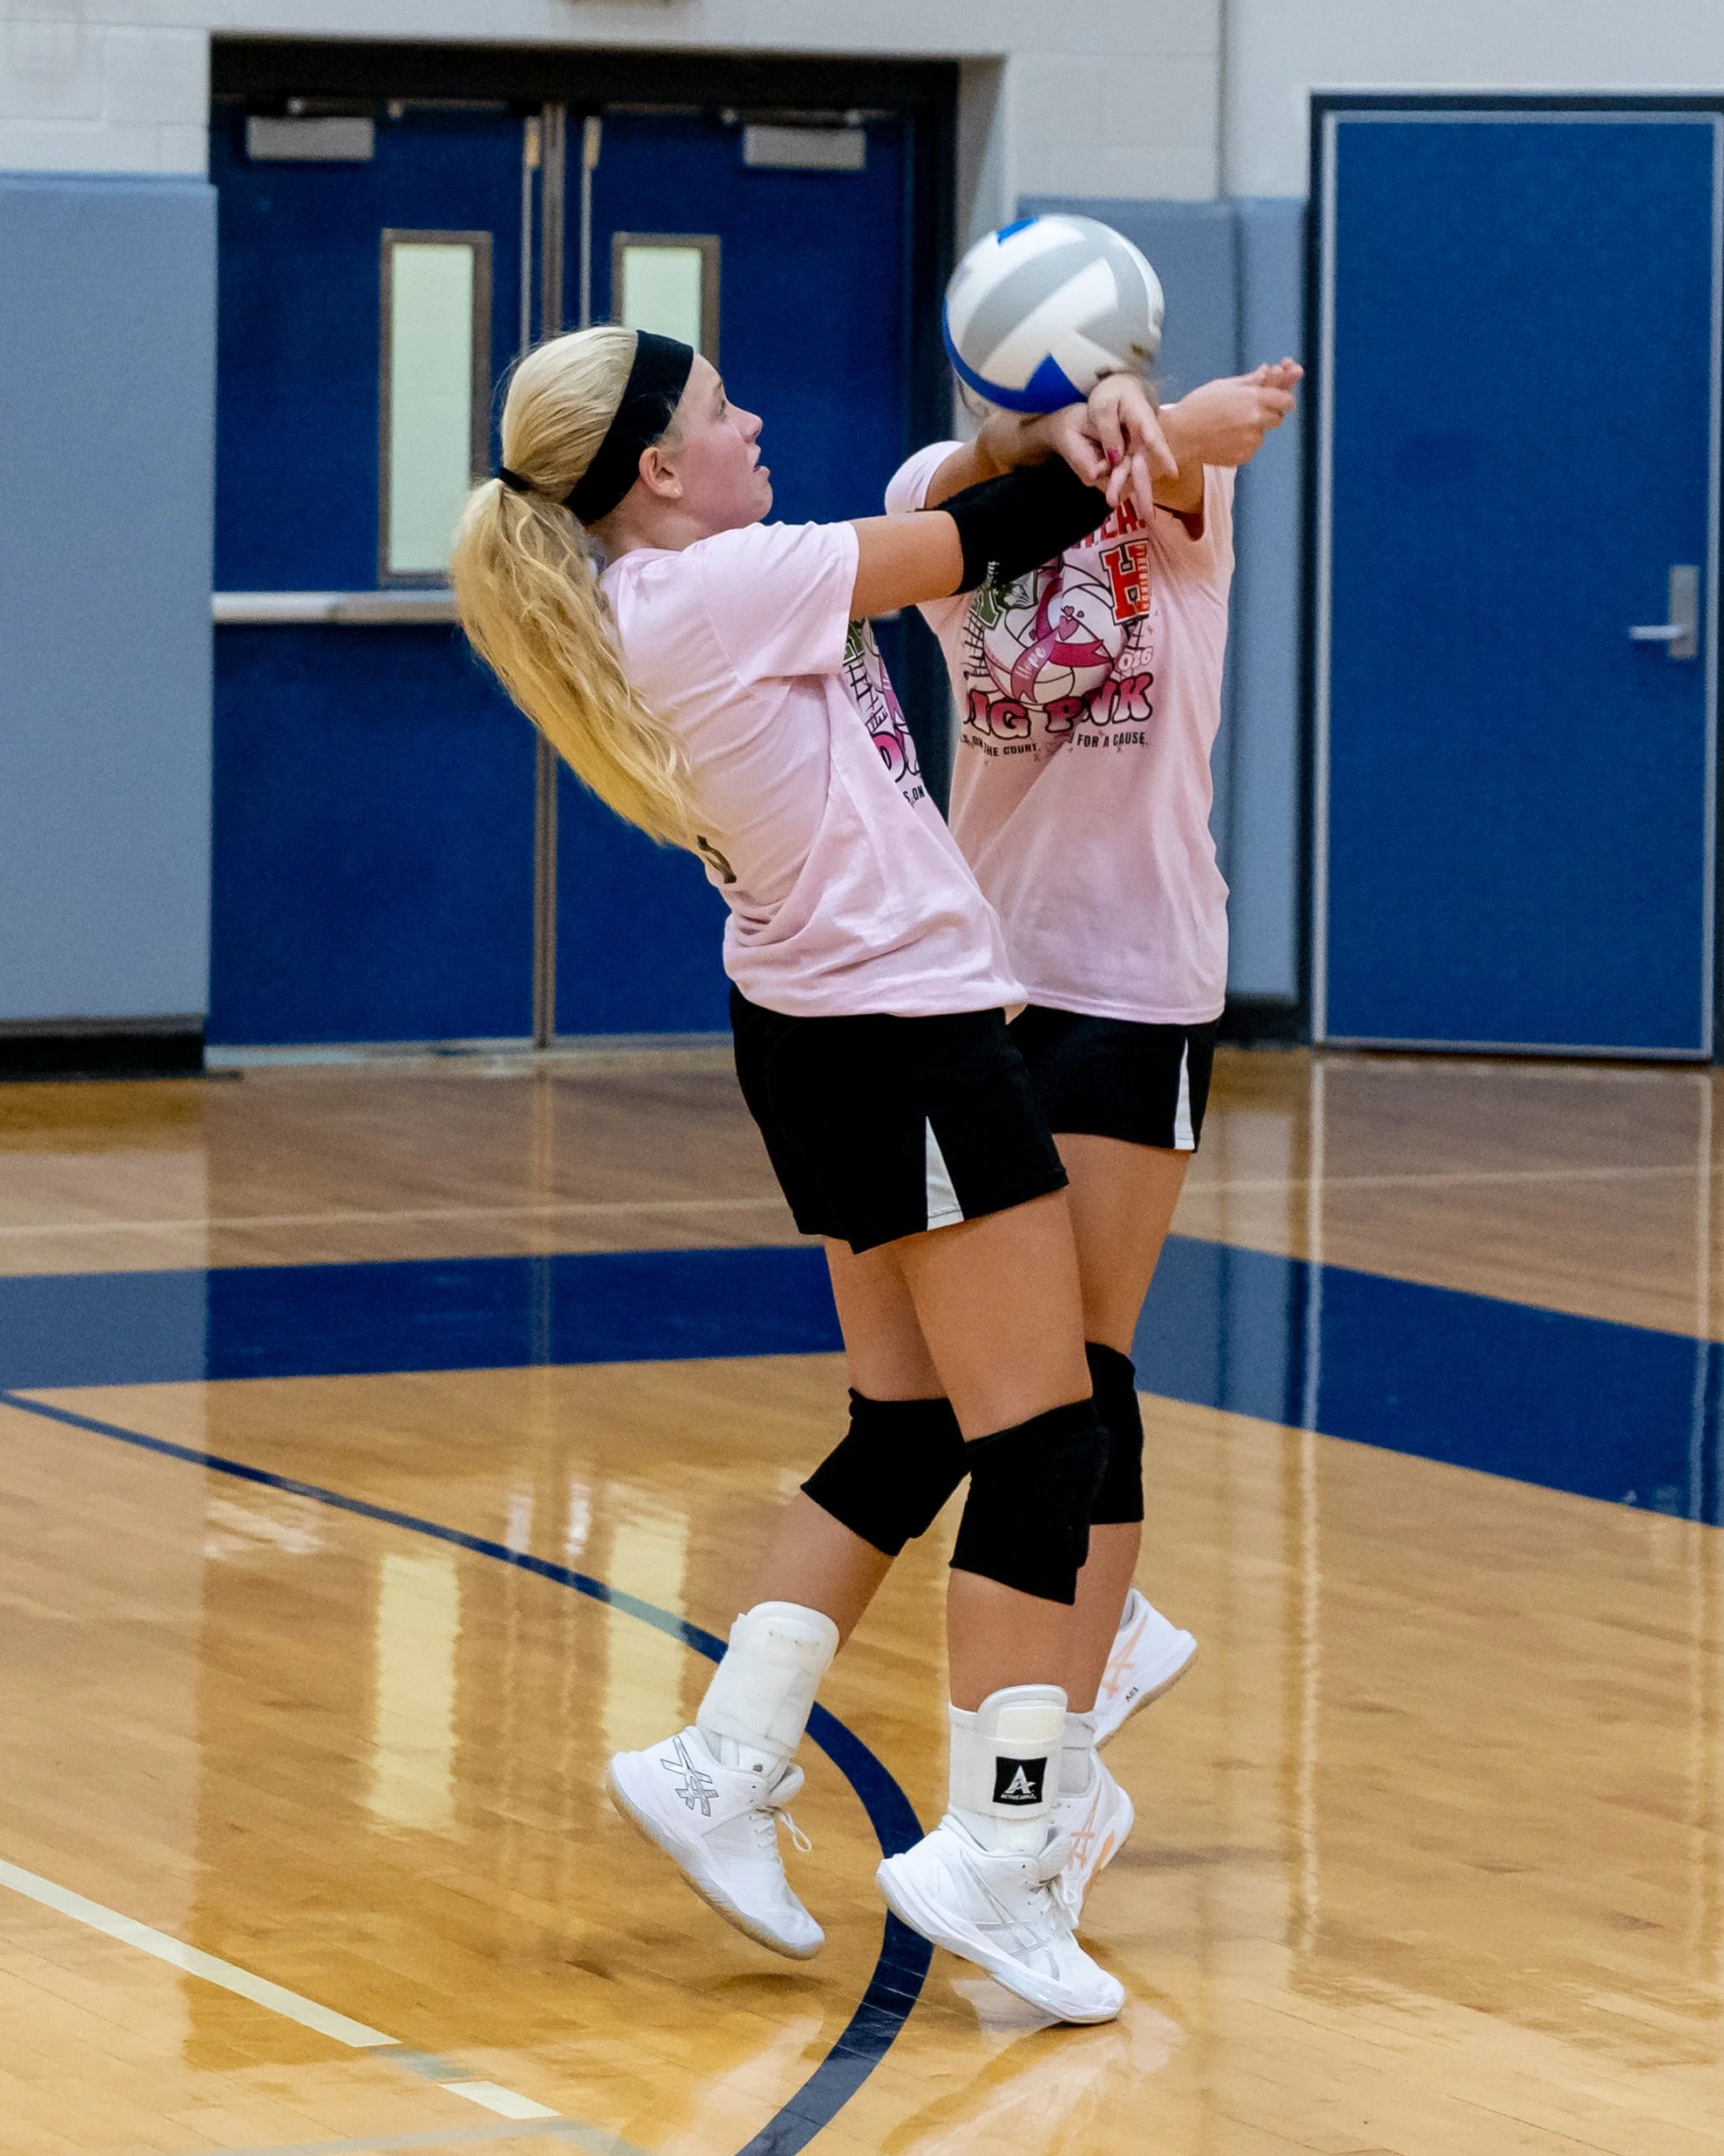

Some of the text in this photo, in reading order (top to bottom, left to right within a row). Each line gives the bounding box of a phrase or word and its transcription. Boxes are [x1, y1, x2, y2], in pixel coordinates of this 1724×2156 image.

[1098, 538, 1150, 626] H
[1014, 647, 1046, 681] Hope
[1117, 645, 1154, 672] 026
[964, 671, 1154, 740] IG PNK
[983, 742, 1000, 757] THE
[1002, 742, 1041, 755] COURT.
[1077, 733, 1099, 748] FOR
[1103, 735, 1110, 748] A
[1113, 731, 1149, 747] CAUSE.
[912, 785, 926, 800] ON
